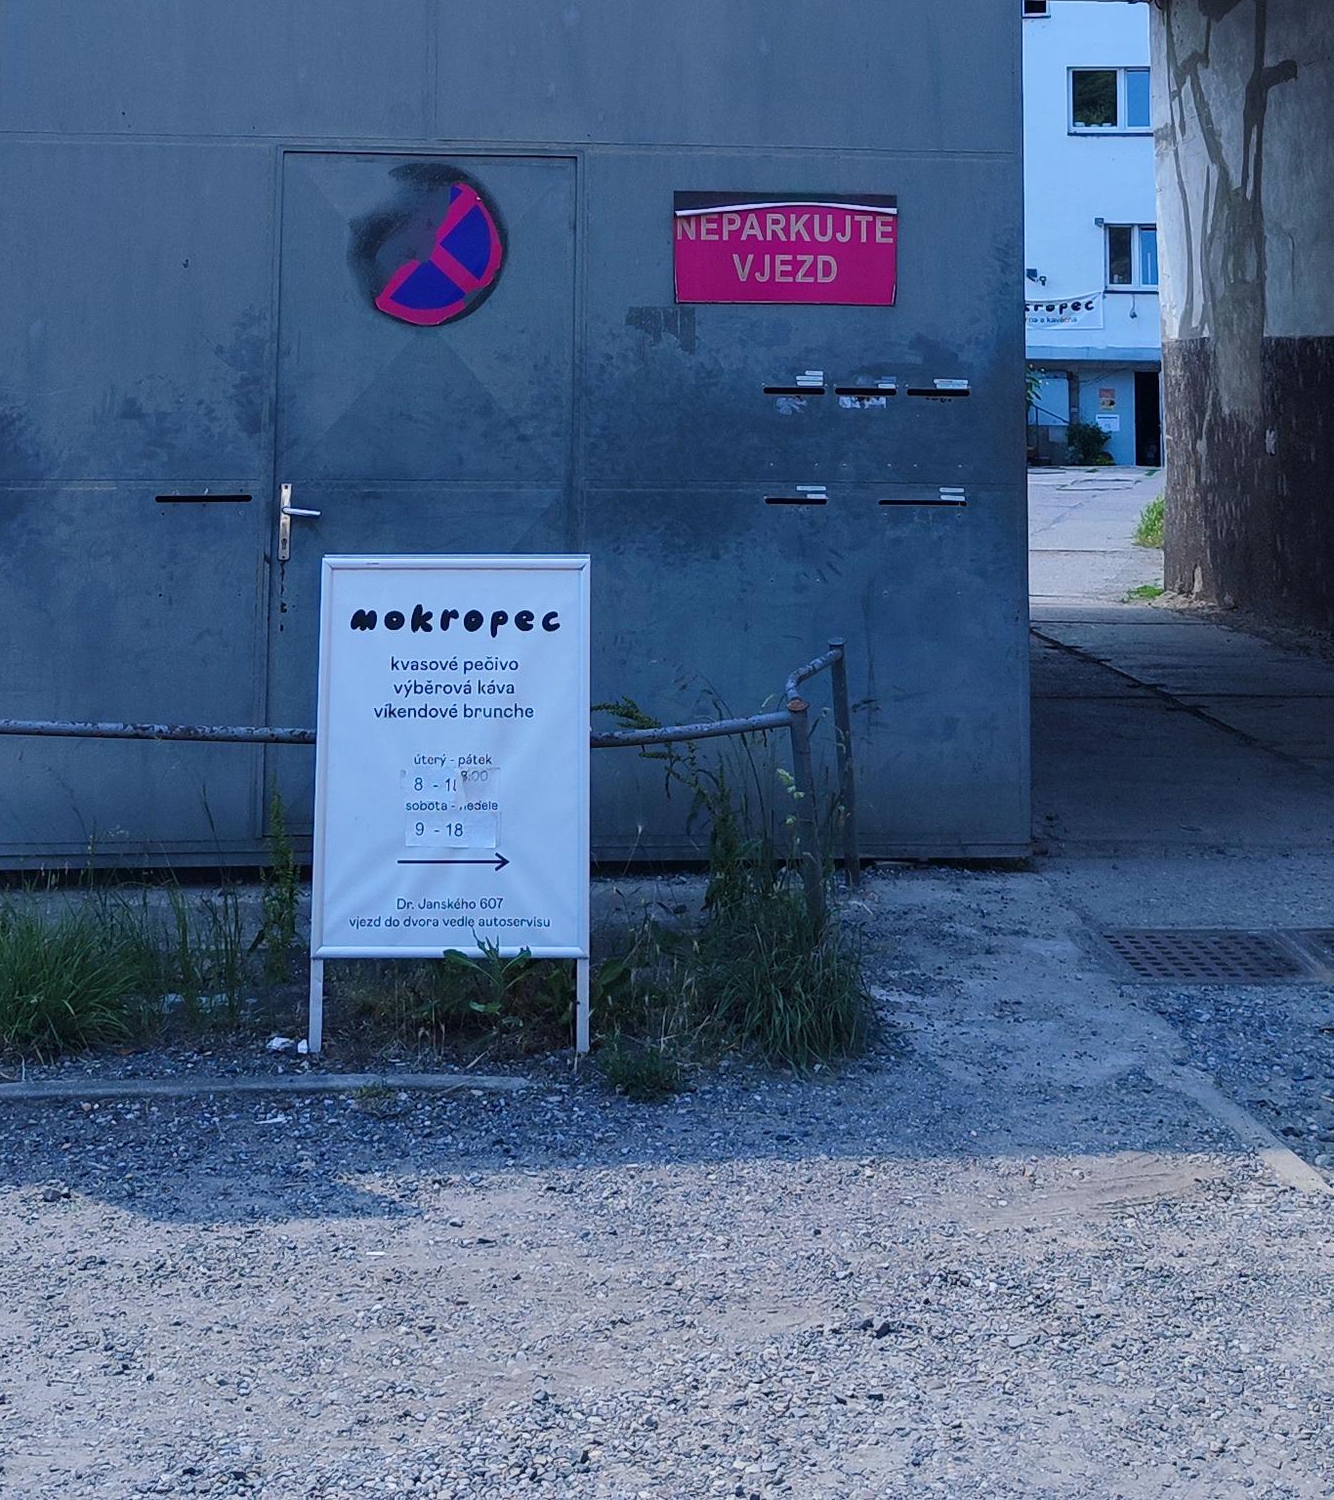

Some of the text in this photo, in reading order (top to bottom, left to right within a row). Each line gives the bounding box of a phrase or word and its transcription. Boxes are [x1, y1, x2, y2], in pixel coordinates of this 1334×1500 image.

[676, 213, 894, 244] NEPARKUJTE
[732, 254, 838, 283] VJEZD
[350, 604, 561, 638] mokropec
[391, 656, 519, 674] kvasové pečivo
[394, 680, 515, 697] výběrová káva
[374, 703, 534, 719] víkendové brunche
[414, 754, 447, 767] úterý
[458, 754, 492, 767] pátek
[414, 777, 423, 791] 8
[406, 801, 447, 811] sobota
[415, 822, 424, 836] 9
[446, 823, 463, 837] 18
[397, 897, 503, 910] Dr. Janského 607
[349, 916, 551, 929] vjezd do dvora vedle autoservisu
